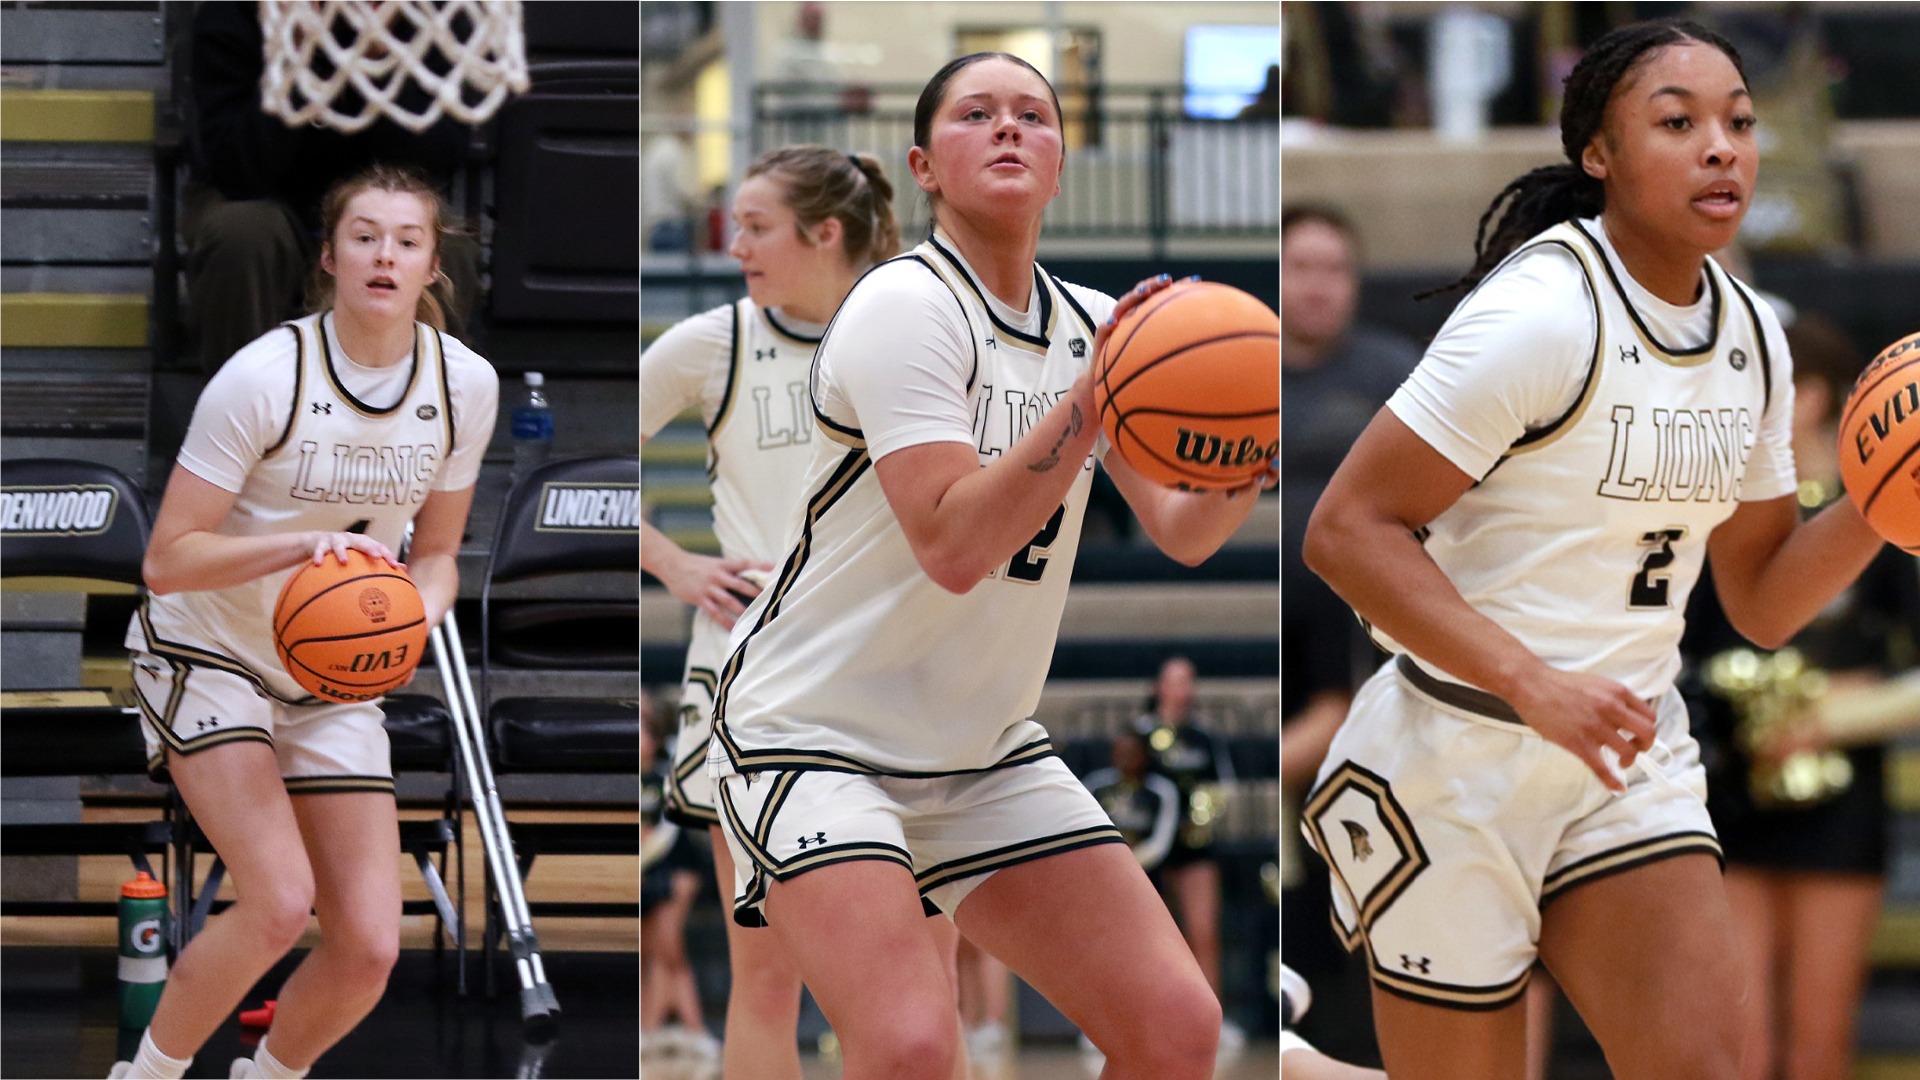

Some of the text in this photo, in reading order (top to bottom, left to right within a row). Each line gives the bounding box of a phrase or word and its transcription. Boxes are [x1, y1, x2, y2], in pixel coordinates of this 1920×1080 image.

[752, 381, 813, 450] LI
[1597, 404, 1754, 502] LIONS
[1855, 382, 1919, 466] EVO
[290, 440, 437, 505] LIONS
[986, 499, 1069, 585] 2
[1626, 524, 1689, 611] 2
[349, 644, 408, 672] EVO
[131, 919, 161, 953] G
